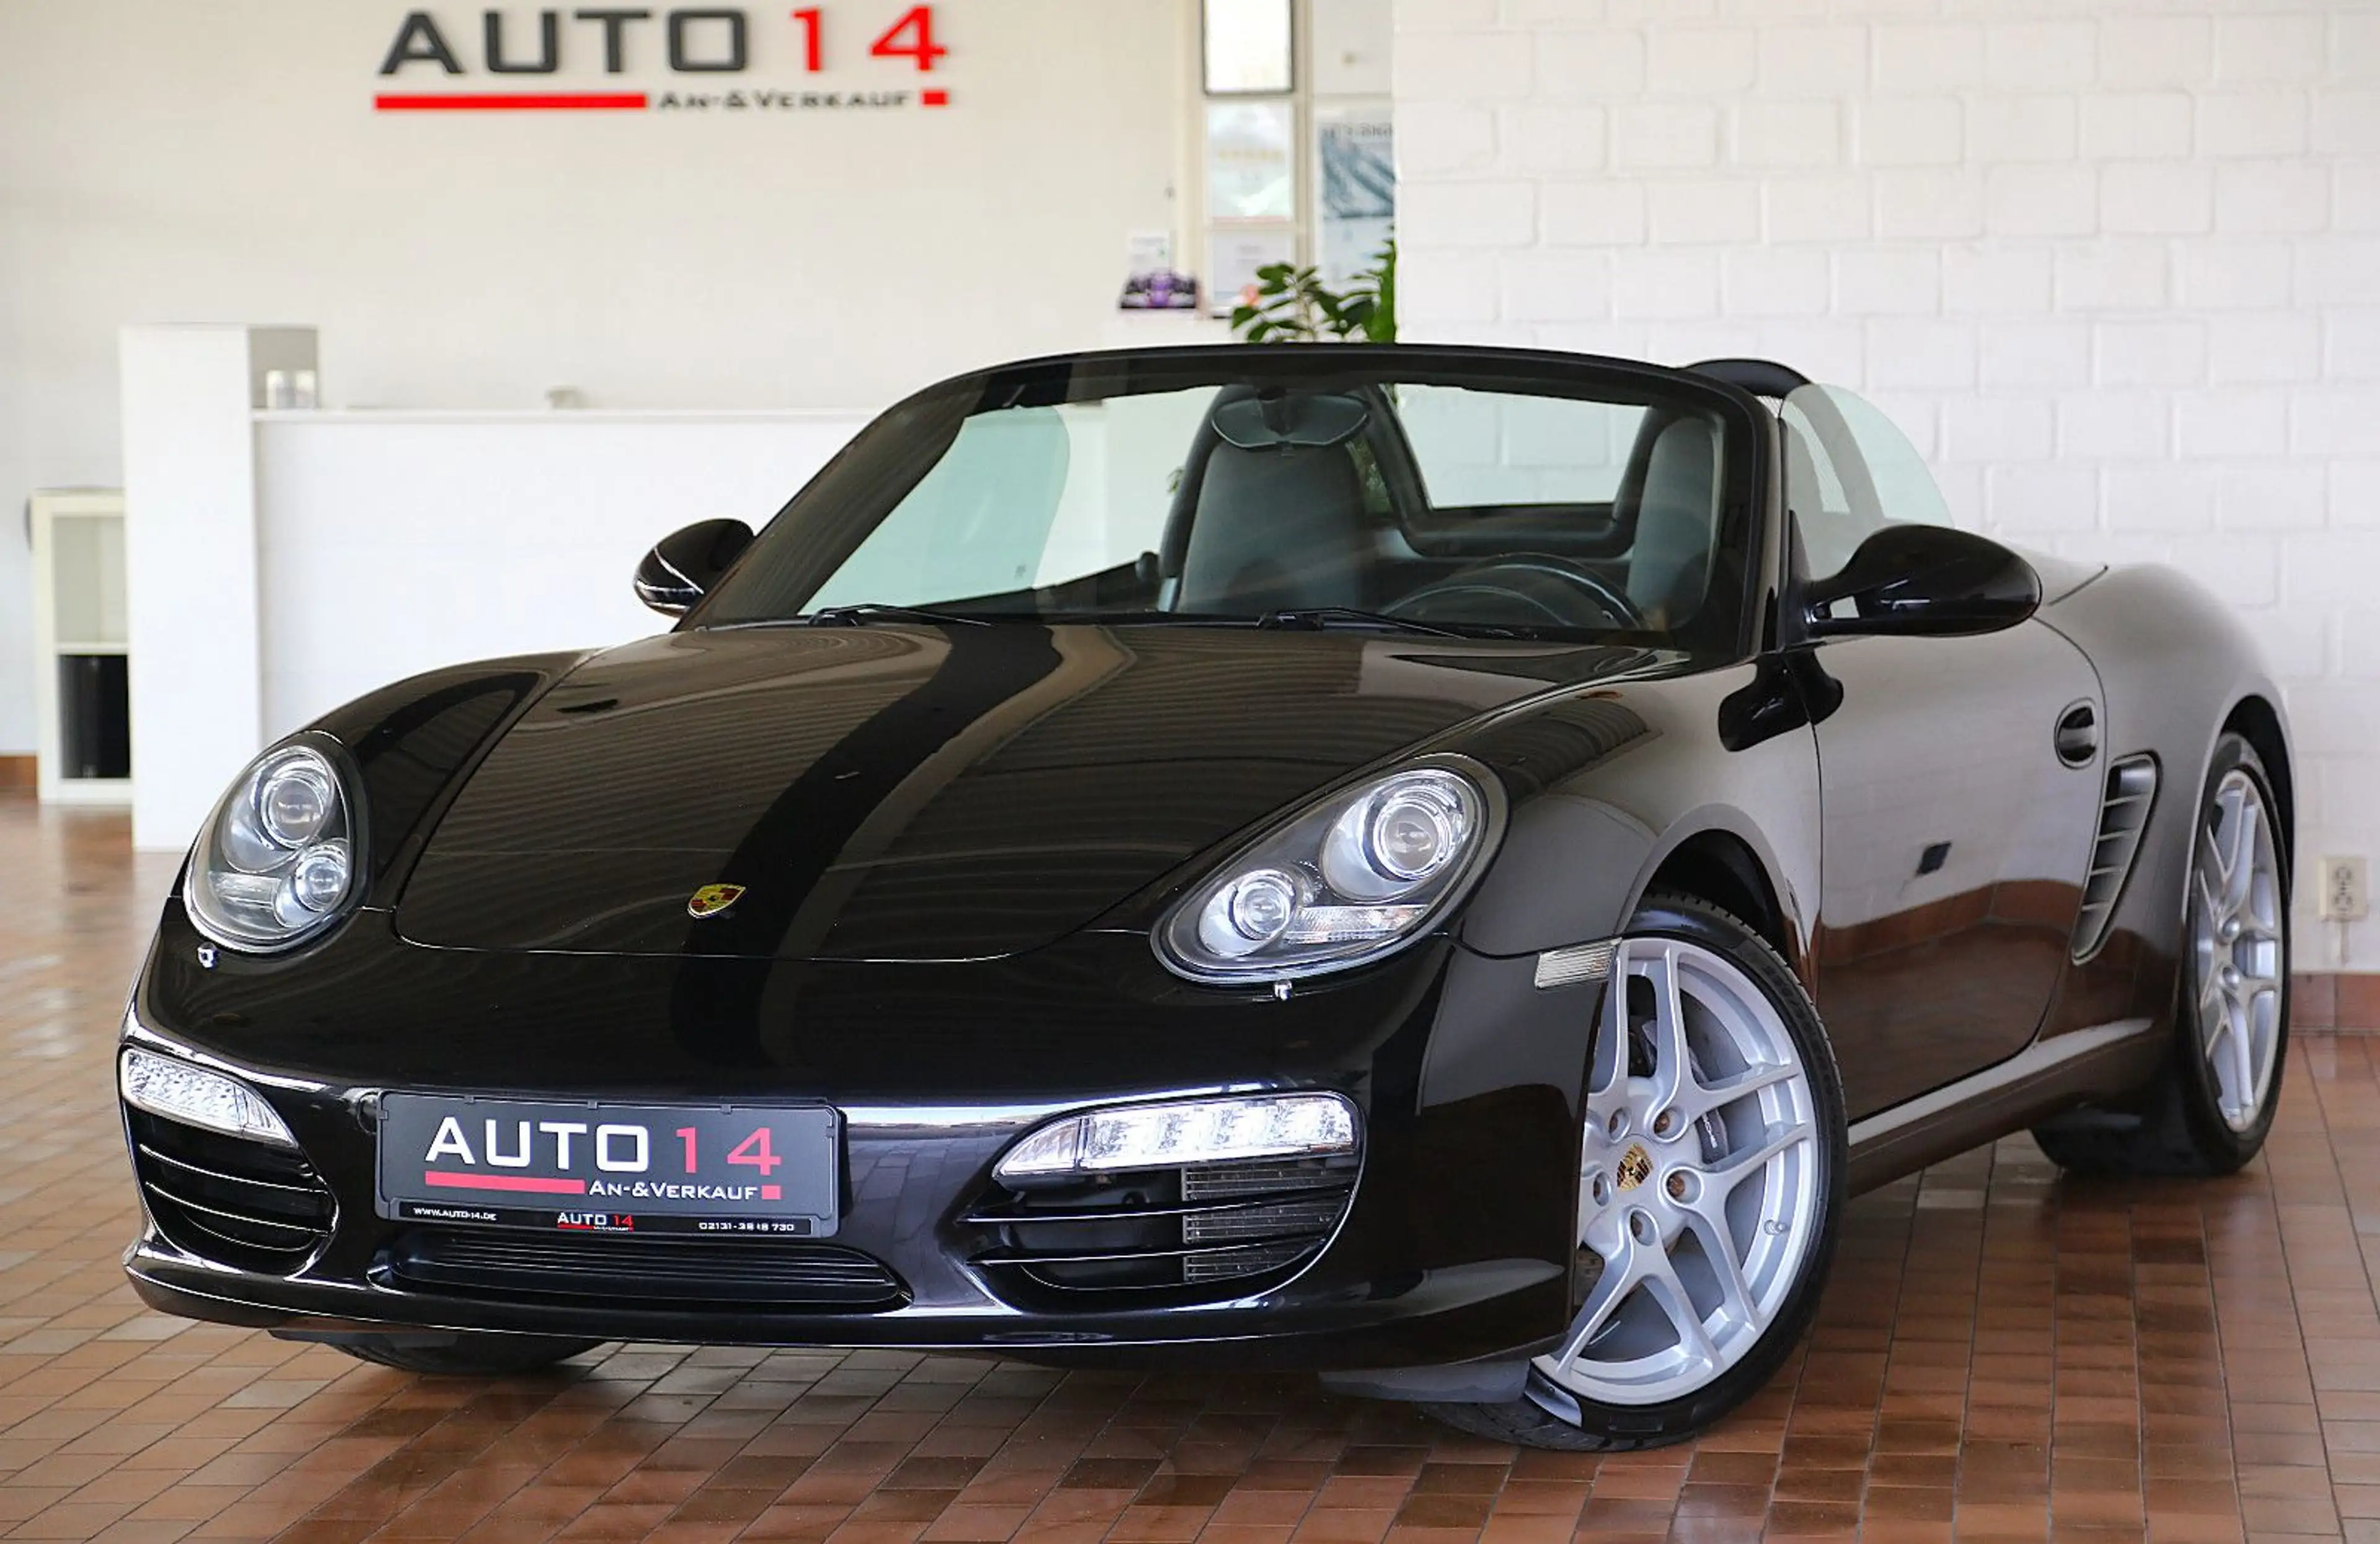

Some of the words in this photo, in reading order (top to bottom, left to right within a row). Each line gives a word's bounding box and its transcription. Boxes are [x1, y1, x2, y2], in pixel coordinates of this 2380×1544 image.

[379, 9, 749, 76] AUTO
[425, 1116, 649, 1172] AUTO
[557, 1212, 607, 1225] AUTO
[614, 1215, 634, 1227] 14
